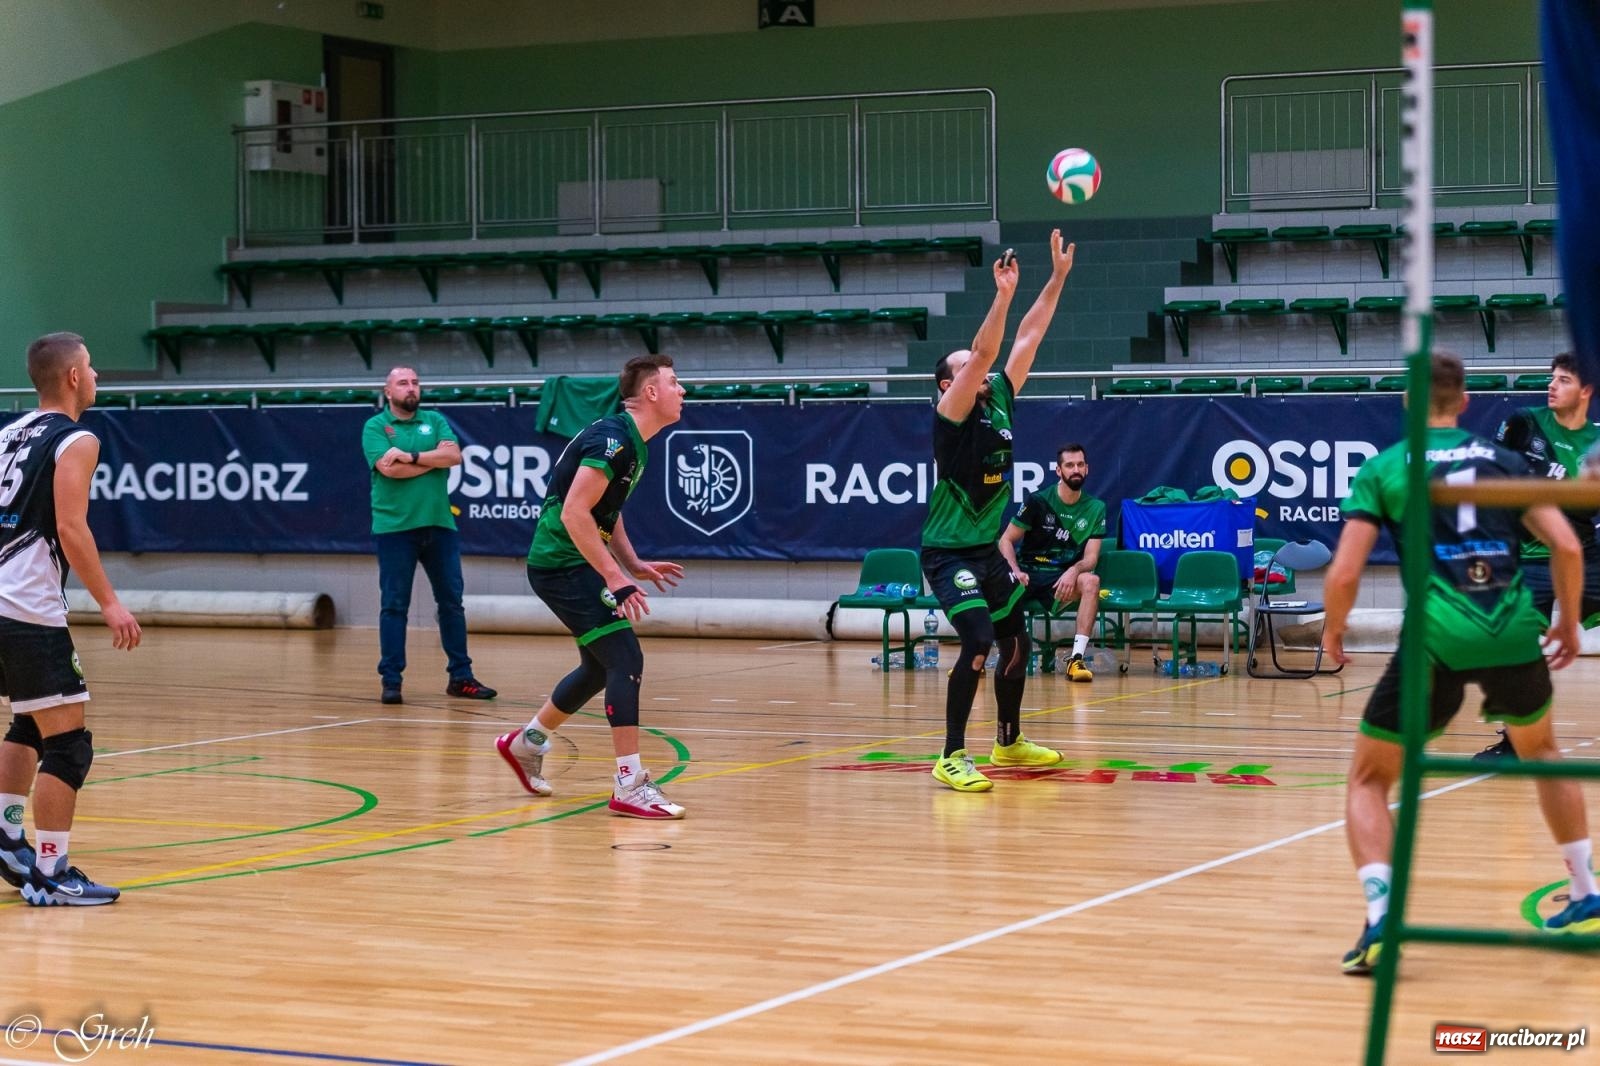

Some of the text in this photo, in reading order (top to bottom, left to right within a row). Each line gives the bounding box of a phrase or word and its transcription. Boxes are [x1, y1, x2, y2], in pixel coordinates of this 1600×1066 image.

[779, 5, 807, 23] A
[89, 449, 309, 501] RACIBÓRZ
[447, 445, 551, 498] SiR
[1547, 463, 1567, 480] 14
[469, 501, 541, 519] RACIBÓR
[1139, 529, 1215, 549] molten
[619, 765, 631, 775] R
[41, 842, 58, 854] R
